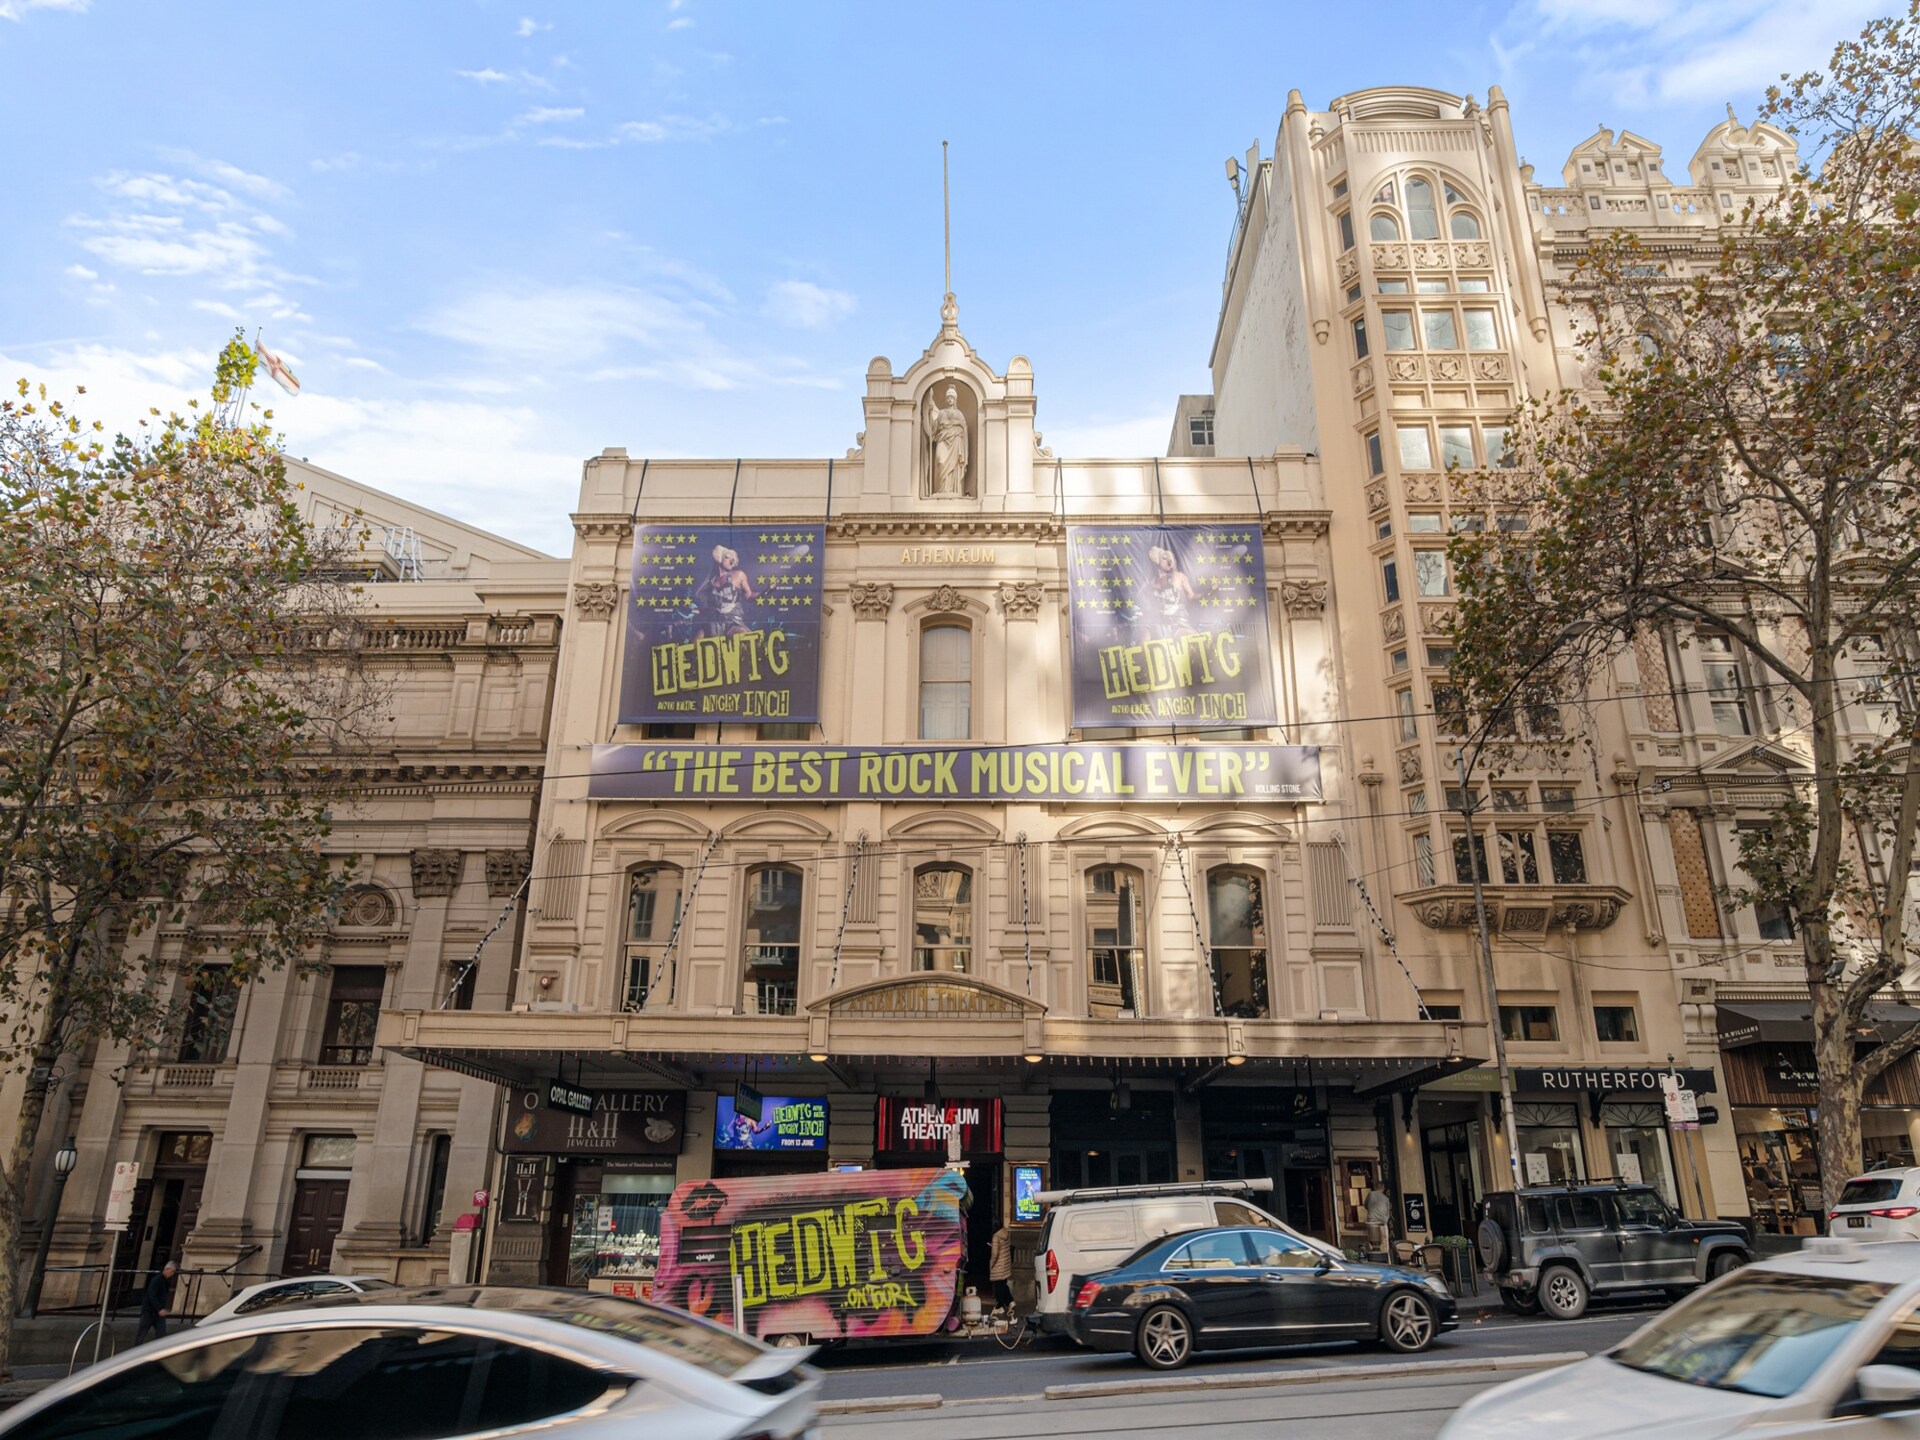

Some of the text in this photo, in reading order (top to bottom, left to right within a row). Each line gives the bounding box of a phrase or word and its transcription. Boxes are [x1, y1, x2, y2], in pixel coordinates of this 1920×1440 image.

[652, 629, 790, 696] HEDWIG
[1098, 631, 1241, 699] HEDWIG
[702, 694, 740, 713] ANGRY
[742, 690, 790, 717] INCH
[1157, 696, 1195, 716] ANGRY
[1198, 692, 1247, 719] INCH
[752, 751, 848, 793] BEST
[859, 752, 960, 794] ROCK
[971, 751, 1135, 794] MUSICAL
[1255, 784, 1301, 793] ROLLING STONE
[1513, 911, 1537, 926] 1915
[1463, 1073, 1493, 1081] COLLINS
[551, 1086, 567, 1103] OPAL
[568, 1090, 592, 1111] GALLERY
[594, 1094, 669, 1112] ALLERY
[1681, 1092, 1692, 1101] 2P
[773, 1103, 811, 1124] HEDWIG
[799, 1120, 824, 1136] INCH
[901, 1123, 956, 1140] THEATR
[566, 1139, 618, 1148] JEWELLERY
[781, 1139, 795, 1147] FROM
[801, 1139, 814, 1147] JUNE
[730, 1197, 926, 1308] HEDWIG
